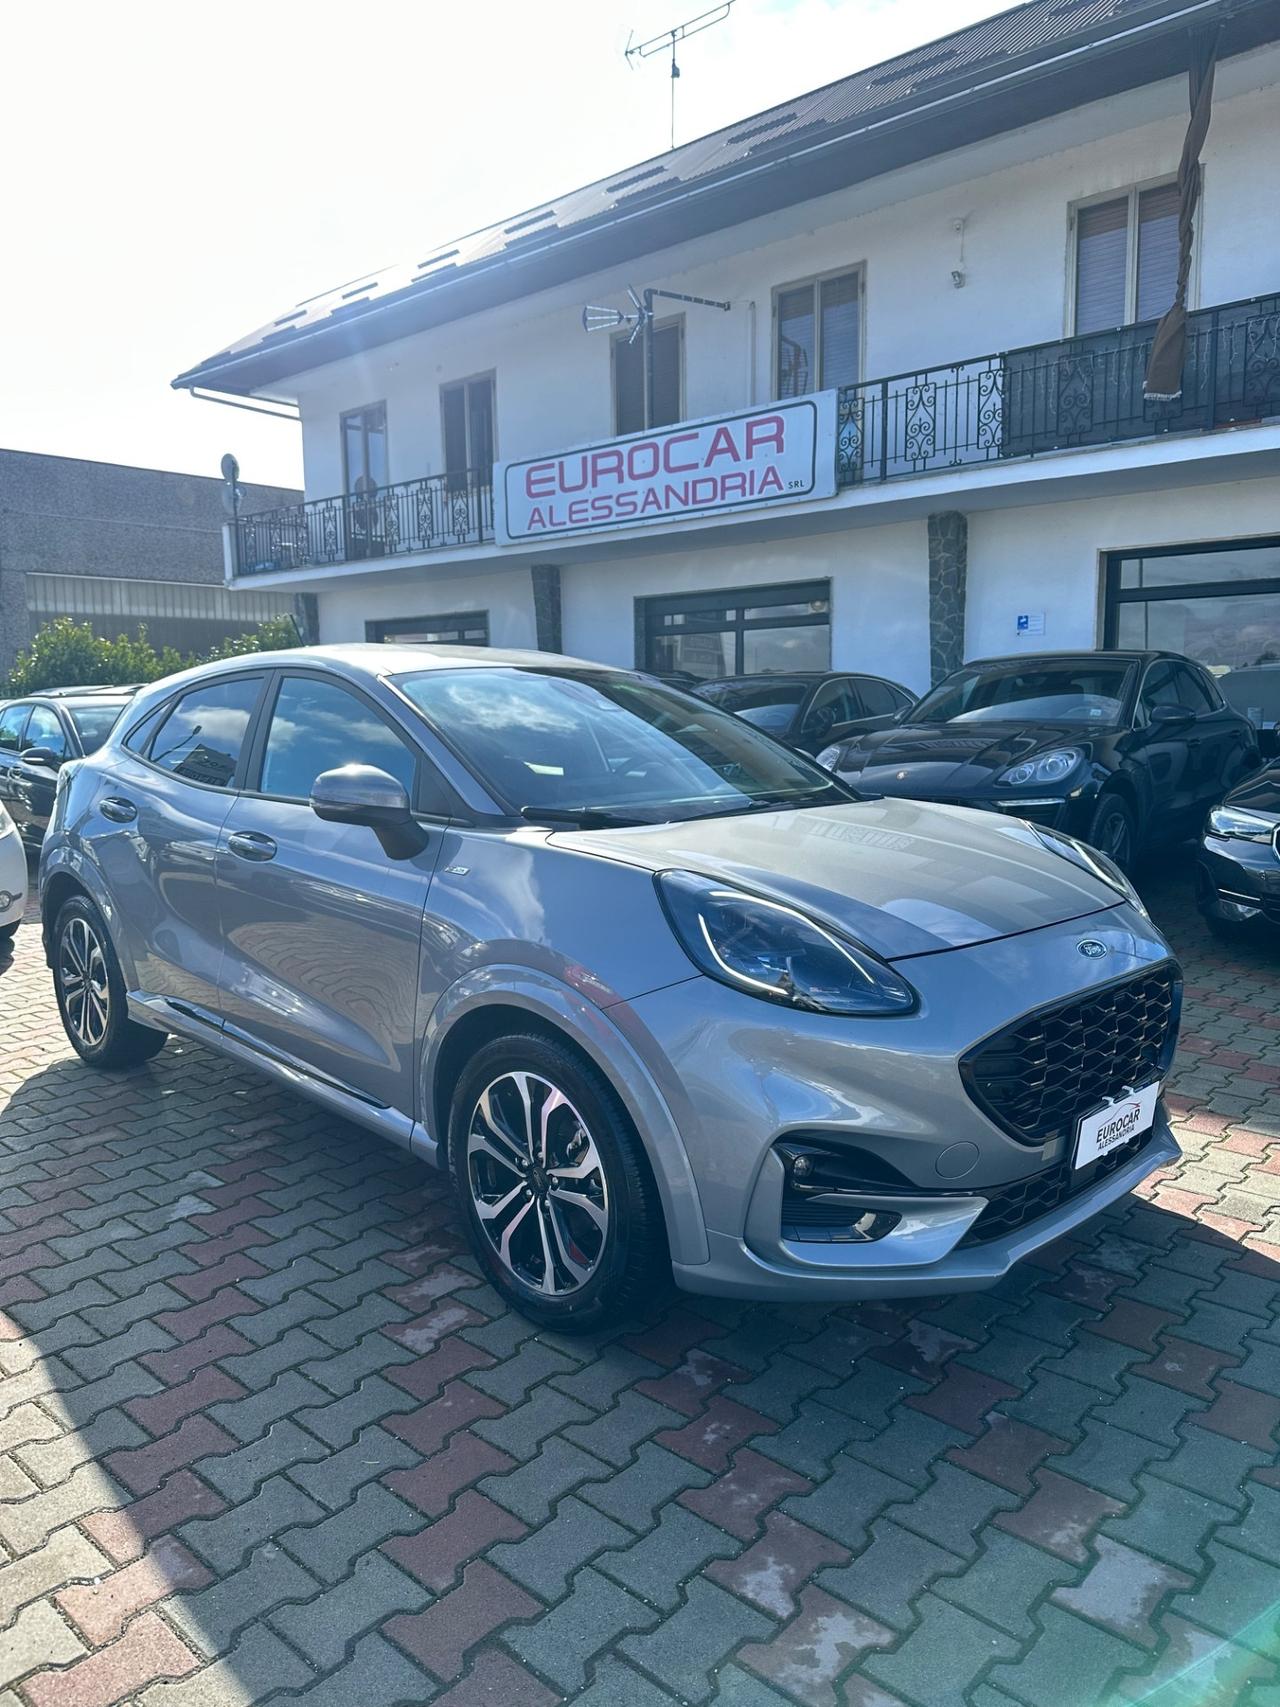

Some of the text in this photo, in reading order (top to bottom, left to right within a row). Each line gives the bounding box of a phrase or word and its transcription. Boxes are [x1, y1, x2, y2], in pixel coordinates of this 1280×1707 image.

[526, 415, 785, 499] EUROCAR
[527, 466, 784, 530] ALESSANDRIA
[788, 479, 805, 490] SRL
[1096, 1108, 1140, 1143] EUROCAR
[1097, 1124, 1135, 1151] ALESSANDRIA
